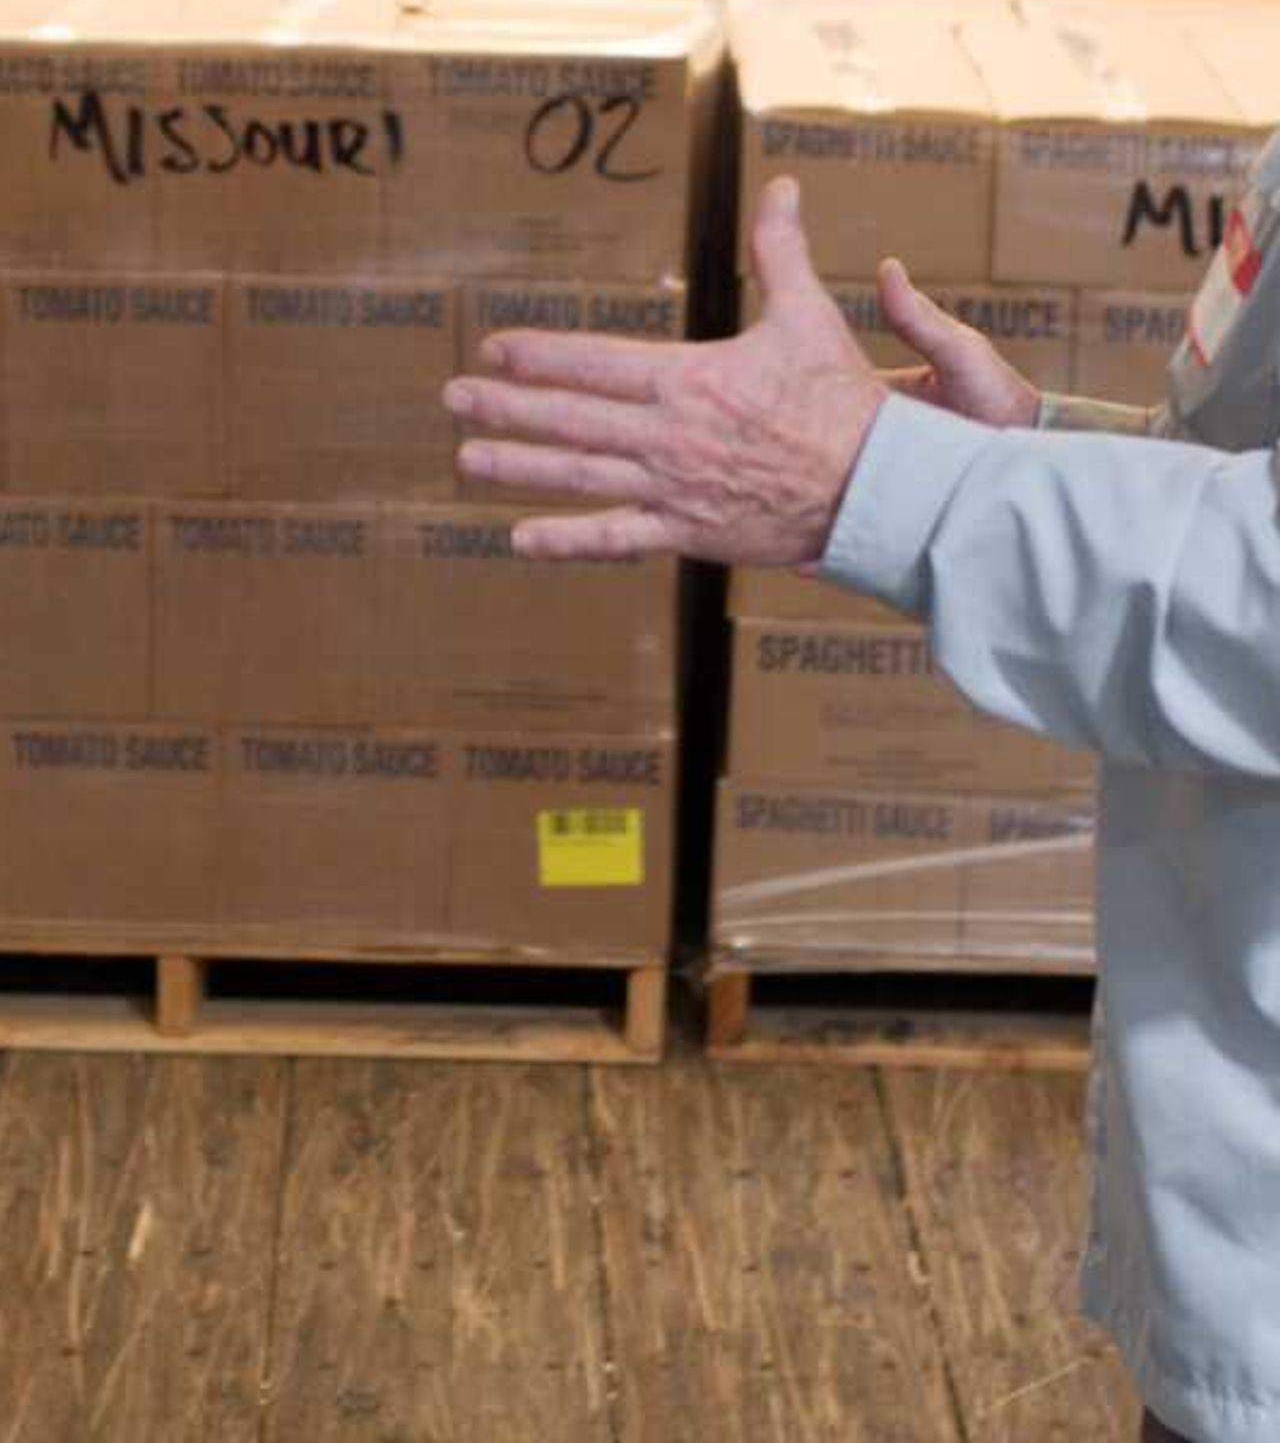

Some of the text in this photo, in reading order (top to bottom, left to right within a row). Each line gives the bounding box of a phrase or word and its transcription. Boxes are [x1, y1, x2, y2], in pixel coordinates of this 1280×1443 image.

[177, 59, 380, 99] TOMATO SAUCE
[429, 59, 658, 100] TOMATO SAUCE
[48, 88, 405, 184] MISSOURI
[16, 286, 215, 325] TOMATO SAUCE
[247, 288, 444, 328] TOMATO SAUCE
[475, 290, 676, 332] TOMATO SAUCE
[953, 294, 1060, 339] SAUCE
[63, 513, 144, 551] SAUCE
[168, 516, 367, 554] TOMATO SAUCE
[11, 732, 212, 772] TOMATO SAUCE
[240, 737, 440, 778] TOMATO SAUCE
[464, 744, 662, 787] TOMATO SAUCE
[735, 791, 868, 837] SPAGHETTI
[874, 800, 953, 840] SAUCE
